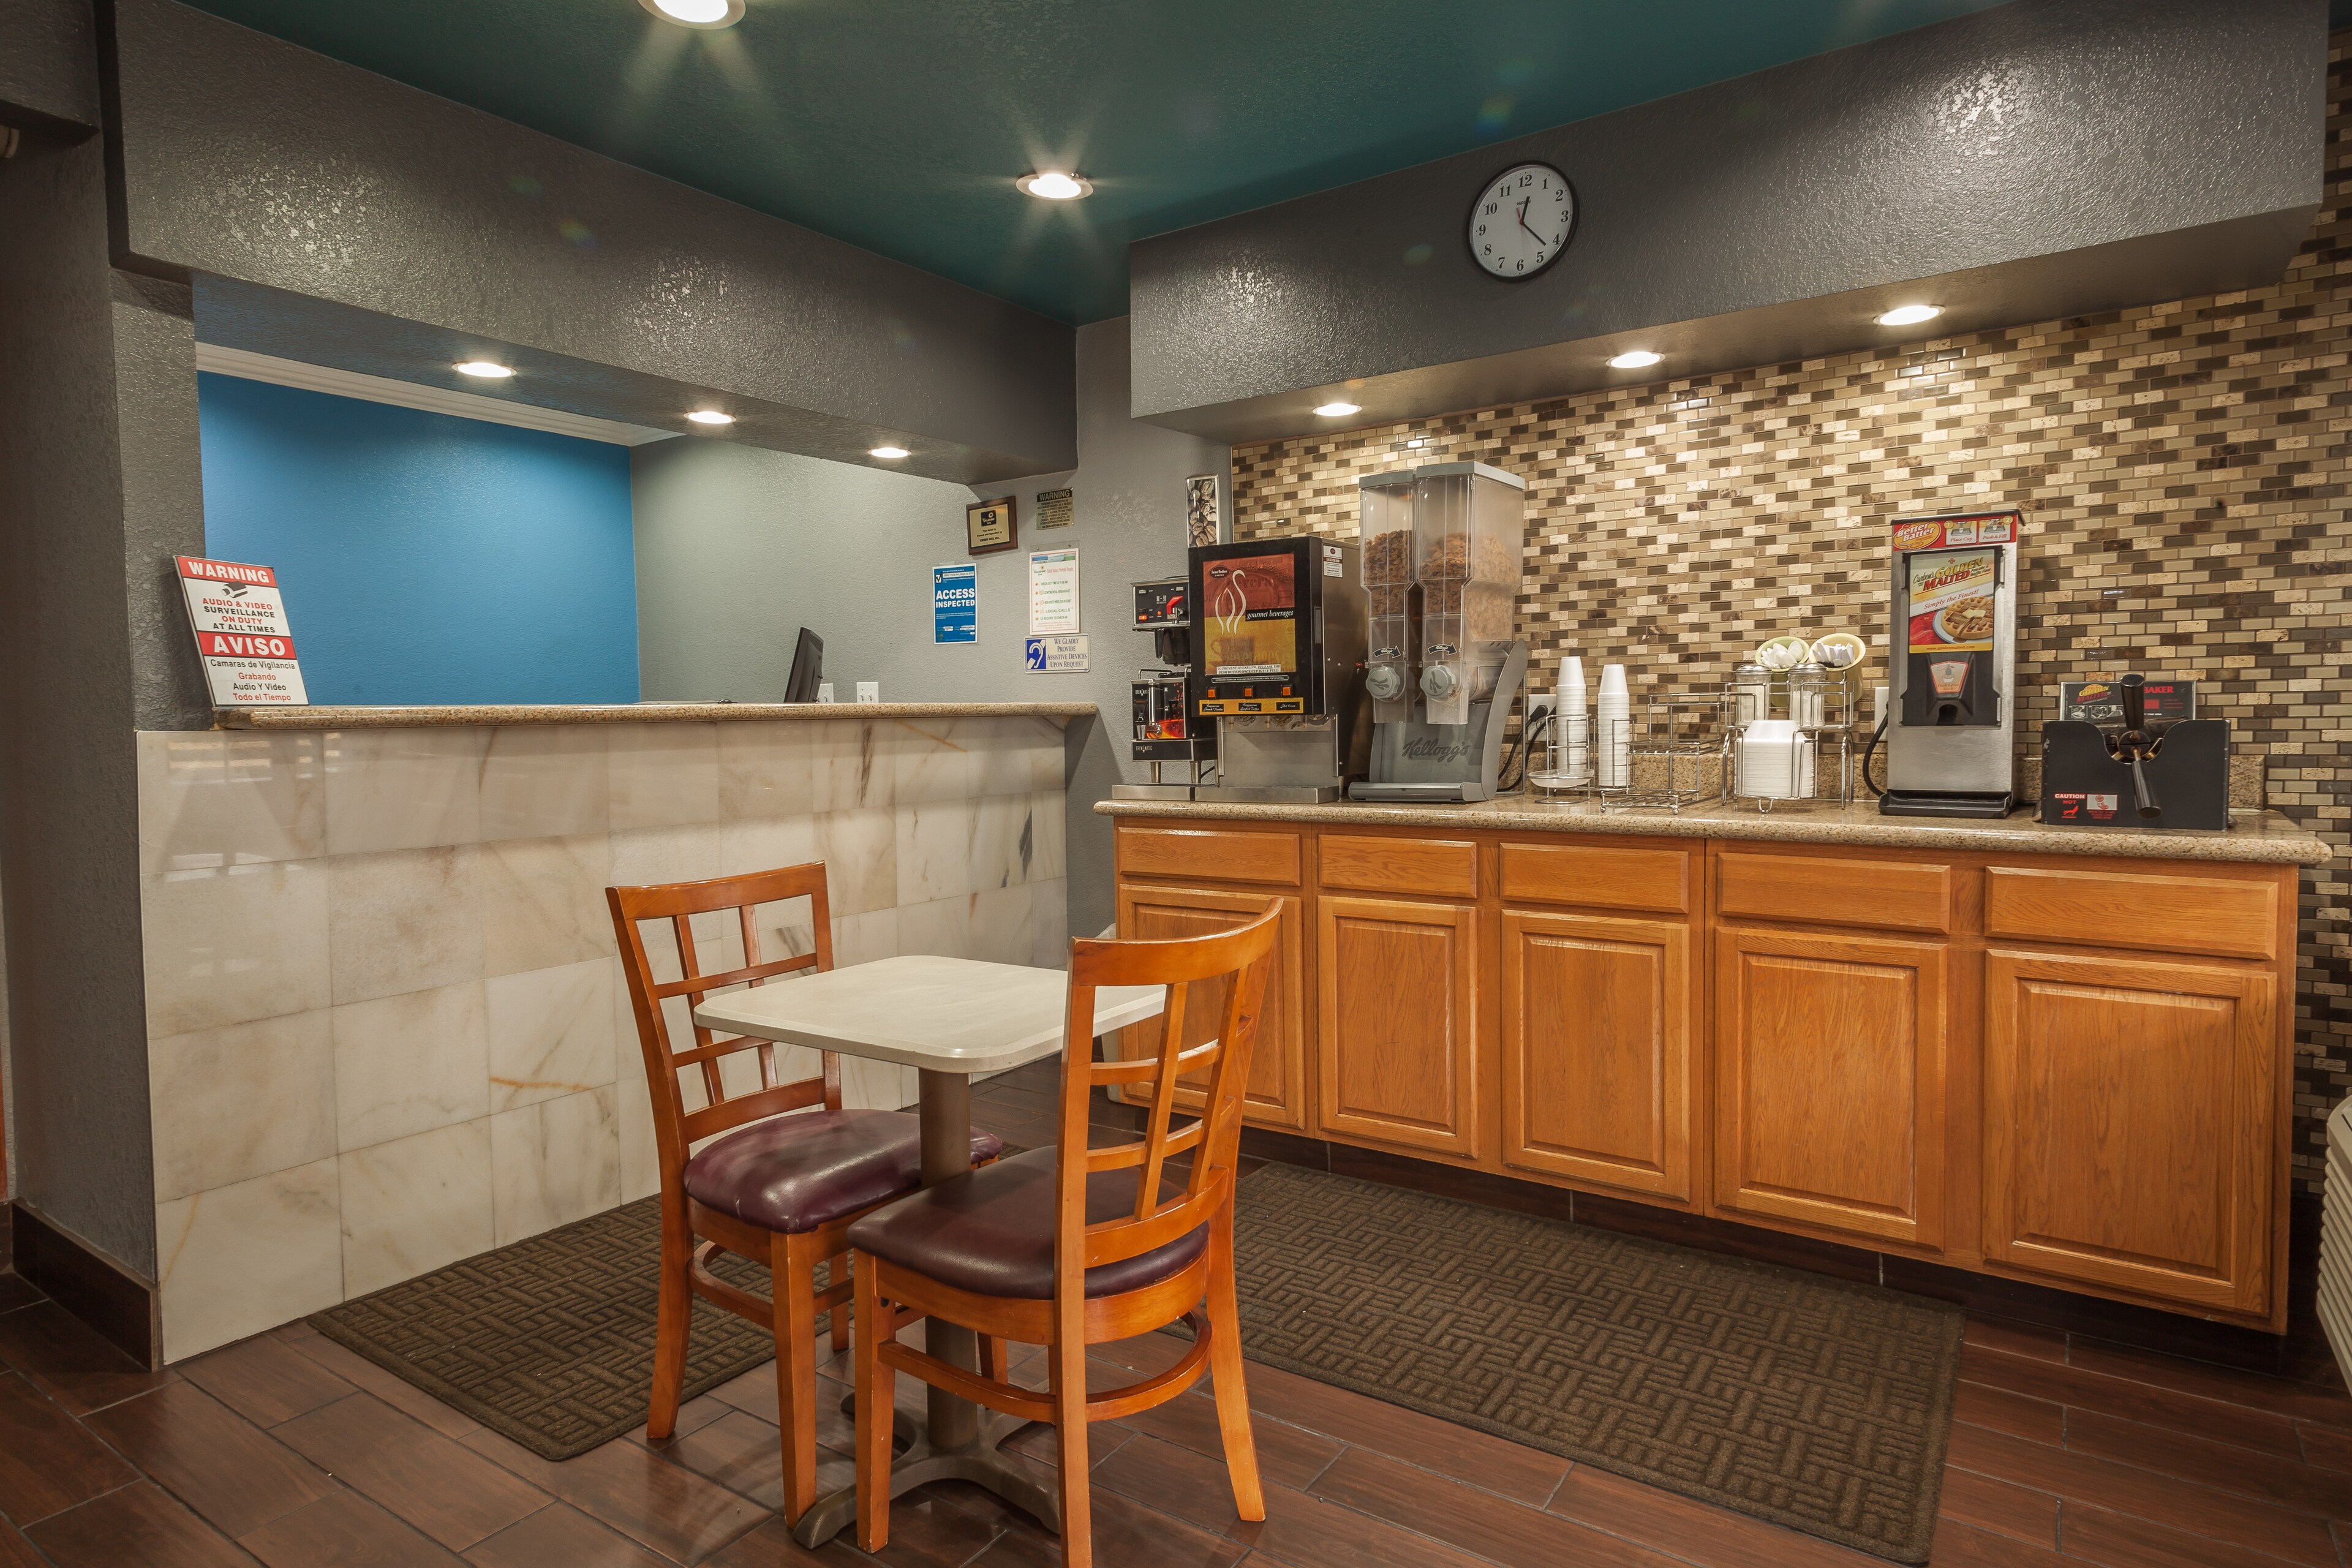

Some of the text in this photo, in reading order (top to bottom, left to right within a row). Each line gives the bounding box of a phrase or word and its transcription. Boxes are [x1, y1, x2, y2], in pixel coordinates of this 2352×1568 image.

[1518, 175, 1532, 188] 12
[1542, 178, 1548, 190] 1
[1499, 184, 1511, 198] 11
[1555, 189, 1563, 202] 2
[1484, 202, 1498, 215] 10
[1561, 210, 1569, 222] 3
[1479, 224, 1486, 236] 9
[1552, 233, 1560, 245] 4
[1484, 244, 1492, 256] 8
[1498, 257, 1505, 269] 7
[1536, 251, 1544, 263] 5
[1516, 259, 1524, 271] 6
[1039, 490, 1070, 501] WARNING
[1897, 523, 1929, 537] Better
[1903, 527, 1935, 541] Batter
[187, 561, 270, 583] WARNING
[1935, 557, 1983, 578] GOLDEN
[1923, 570, 1971, 591] MALTED
[936, 588, 975, 600] ACCESS
[1924, 599, 1945, 609] Simply
[1958, 589, 1979, 599] Finest!
[203, 598, 232, 607] AUDIO
[936, 600, 975, 608] INSPECTED
[204, 606, 275, 618] SURVEILLANCE
[214, 636, 285, 656] AVISO
[210, 659, 246, 668] Camaras
[258, 661, 295, 670] Vigilancia
[238, 672, 276, 680] Grabando
[263, 694, 291, 702] Tiempo
[1402, 737, 1470, 763] Kellogg's
